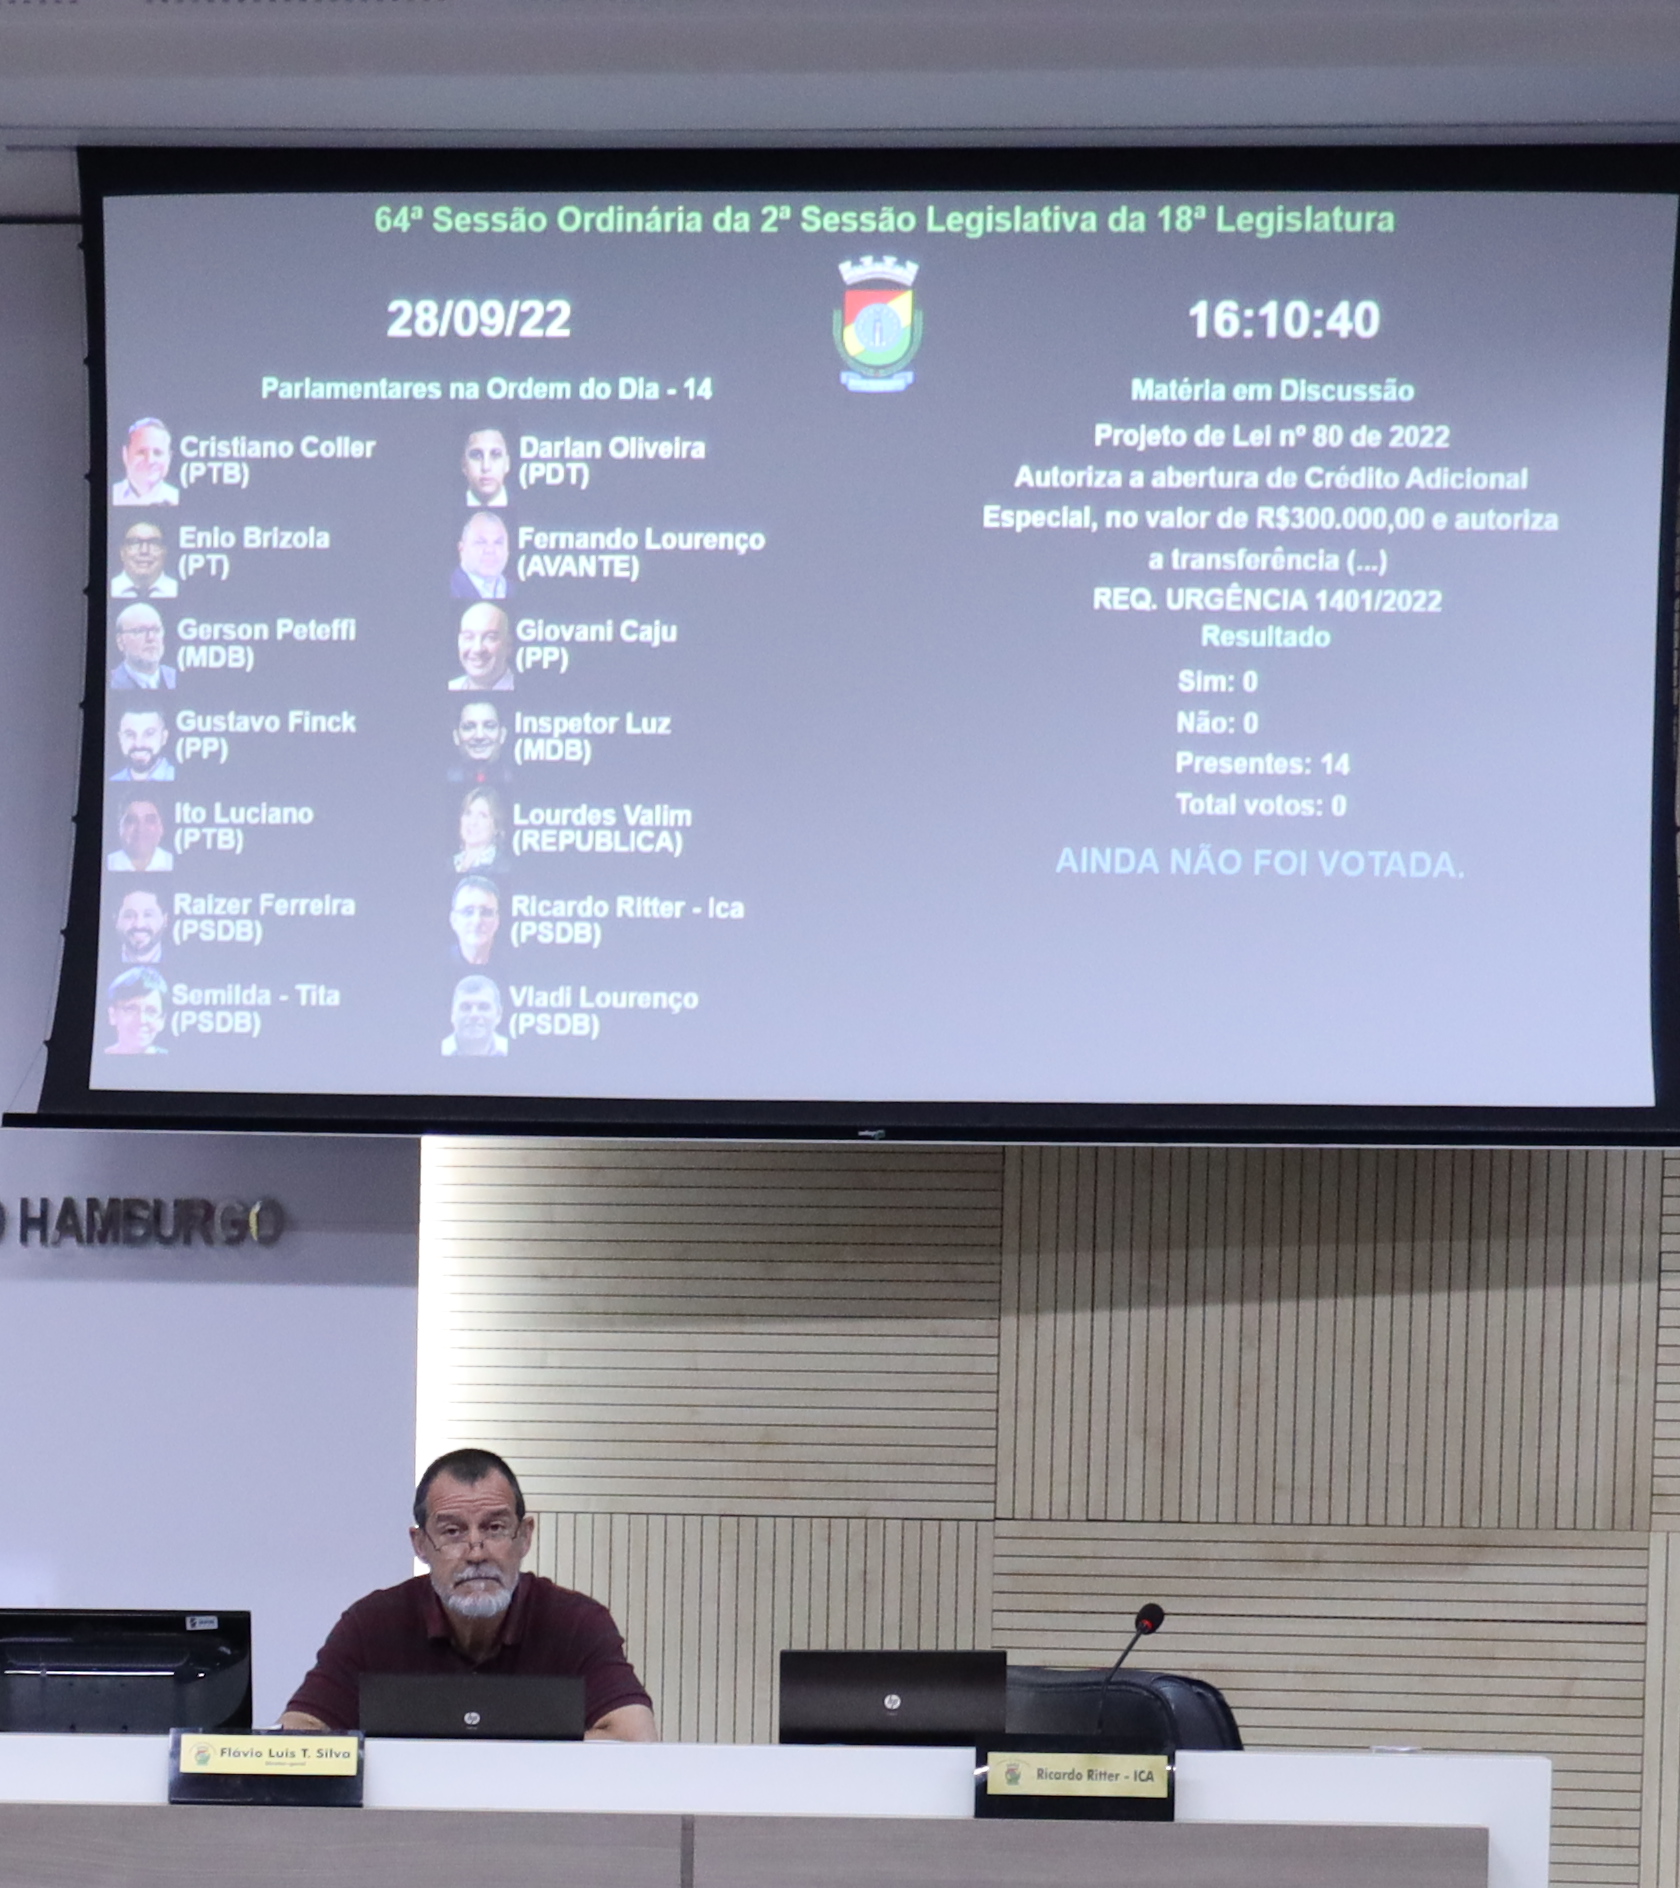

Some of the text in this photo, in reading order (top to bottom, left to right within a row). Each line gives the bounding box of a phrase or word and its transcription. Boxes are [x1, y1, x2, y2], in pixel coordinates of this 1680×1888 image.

[433, 206, 547, 232] Sessão
[558, 206, 702, 232] Ordinária
[713, 206, 749, 232] da
[801, 205, 916, 232] Sessão
[1108, 206, 1145, 232] da
[1217, 205, 1394, 238] Legislatura
[387, 299, 570, 337] 28/09/22
[1190, 300, 1380, 338] 16:10:40
[262, 377, 441, 399] Parlamentares
[450, 382, 479, 399] na
[487, 377, 571, 399] Ordem
[579, 377, 611, 399] do
[619, 377, 659, 399] Dia
[684, 377, 712, 400] 14
[1132, 378, 1414, 401] Matéria em Discussão
[180, 436, 376, 458] Cristiano Coller
[520, 436, 705, 458] Darlan Oliveira
[1095, 423, 1187, 451] Projeto
[1194, 424, 1225, 447] de
[1233, 424, 1271, 446] Lei
[1313, 425, 1343, 447] 80
[1350, 425, 1382, 447] de
[1389, 425, 1450, 448] 2022
[180, 462, 249, 488] (PTB)
[519, 462, 589, 489] (PDT)
[1015, 465, 1528, 489] Autoriza a abertura de Crédito Adicional
[984, 505, 1558, 534] Especial, no valor de R$300.000,00 e autoriza
[180, 526, 330, 548] Enio Brizola
[519, 527, 765, 555] Fernando Lourenço
[179, 554, 229, 580] (PT)
[518, 555, 639, 582] (AVANTE)
[1149, 546, 1387, 576] a transferência (...)
[1094, 582, 1442, 612] REQ. URGÊNCIA 1401/2022
[178, 618, 355, 640] Gerson Peteffi
[516, 619, 677, 647] Giovani Caju
[1202, 624, 1330, 647] Resultado
[177, 645, 254, 672] (MDB)
[516, 646, 568, 673] (PP)
[1178, 669, 1258, 692] Sim: 0
[176, 710, 356, 732] Gustavo Finck
[514, 711, 671, 738] Inspetor Luz
[1177, 710, 1258, 733] Não: 0
[176, 737, 228, 764] (PP)
[515, 735, 591, 765] (MDB)
[1177, 751, 1350, 775] Presentes: 14
[175, 802, 314, 824] Ito Luciano
[514, 804, 691, 826] Lourdes Valim
[1176, 793, 1346, 816] Total votos: 0
[175, 828, 243, 854] (PTB)
[513, 829, 682, 857] (REPUBLICA)
[1056, 843, 1464, 878] AINDA NÃO FOI VOTADA.
[174, 893, 355, 915] Raizer Ferreira
[512, 895, 609, 917] Ricardo
[617, 896, 686, 918] Ritter
[709, 897, 744, 918] Ica
[173, 919, 262, 945] (PSDB)
[511, 921, 601, 948] (PSDB)
[172, 984, 271, 1005] Semilda
[295, 984, 340, 1005] Tita
[510, 986, 698, 1014] Vladi Lourenço
[171, 1011, 261, 1037] (PSDB)
[509, 1013, 599, 1040] (PSDB)
[20, 1194, 287, 1248] HAMBURGO
[221, 1748, 262, 1758] Flávio
[301, 1748, 311, 1759] T.
[317, 1749, 350, 1758] Silva
[1037, 1768, 1083, 1781] Ricardo
[1087, 1769, 1120, 1781] Ritter
[1134, 1770, 1154, 1782] ICA
